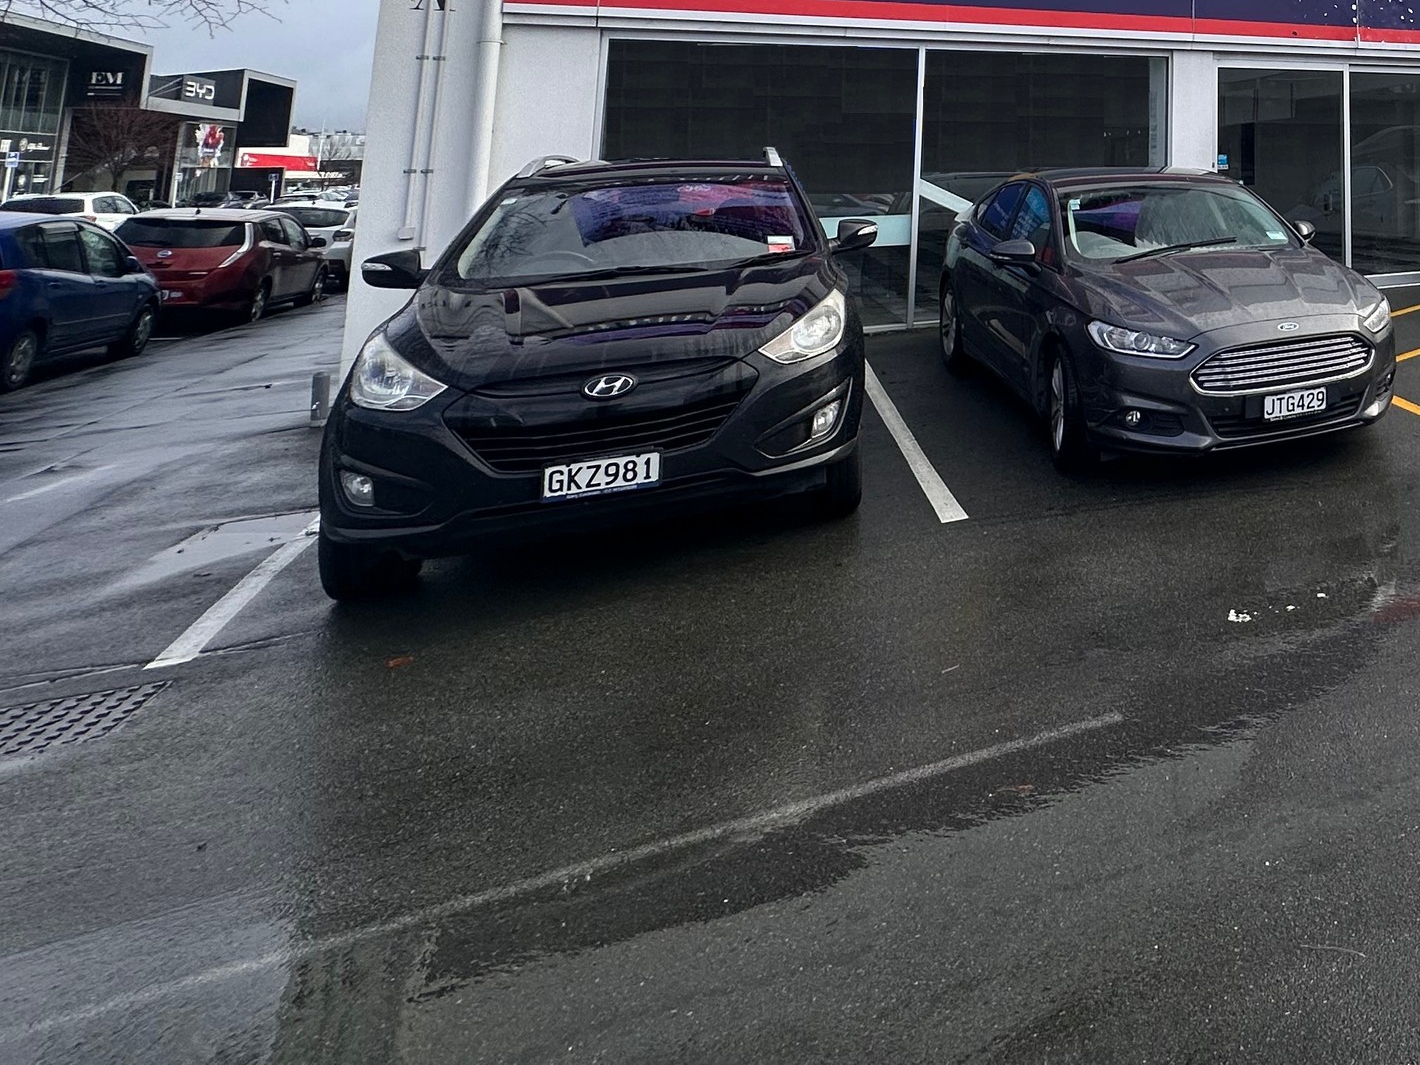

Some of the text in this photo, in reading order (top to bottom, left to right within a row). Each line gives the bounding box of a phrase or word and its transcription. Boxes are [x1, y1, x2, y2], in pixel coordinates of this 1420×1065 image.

[185, 81, 215, 100] BYD
[1266, 390, 1325, 416] JTG429
[548, 456, 652, 493] GKZ981
